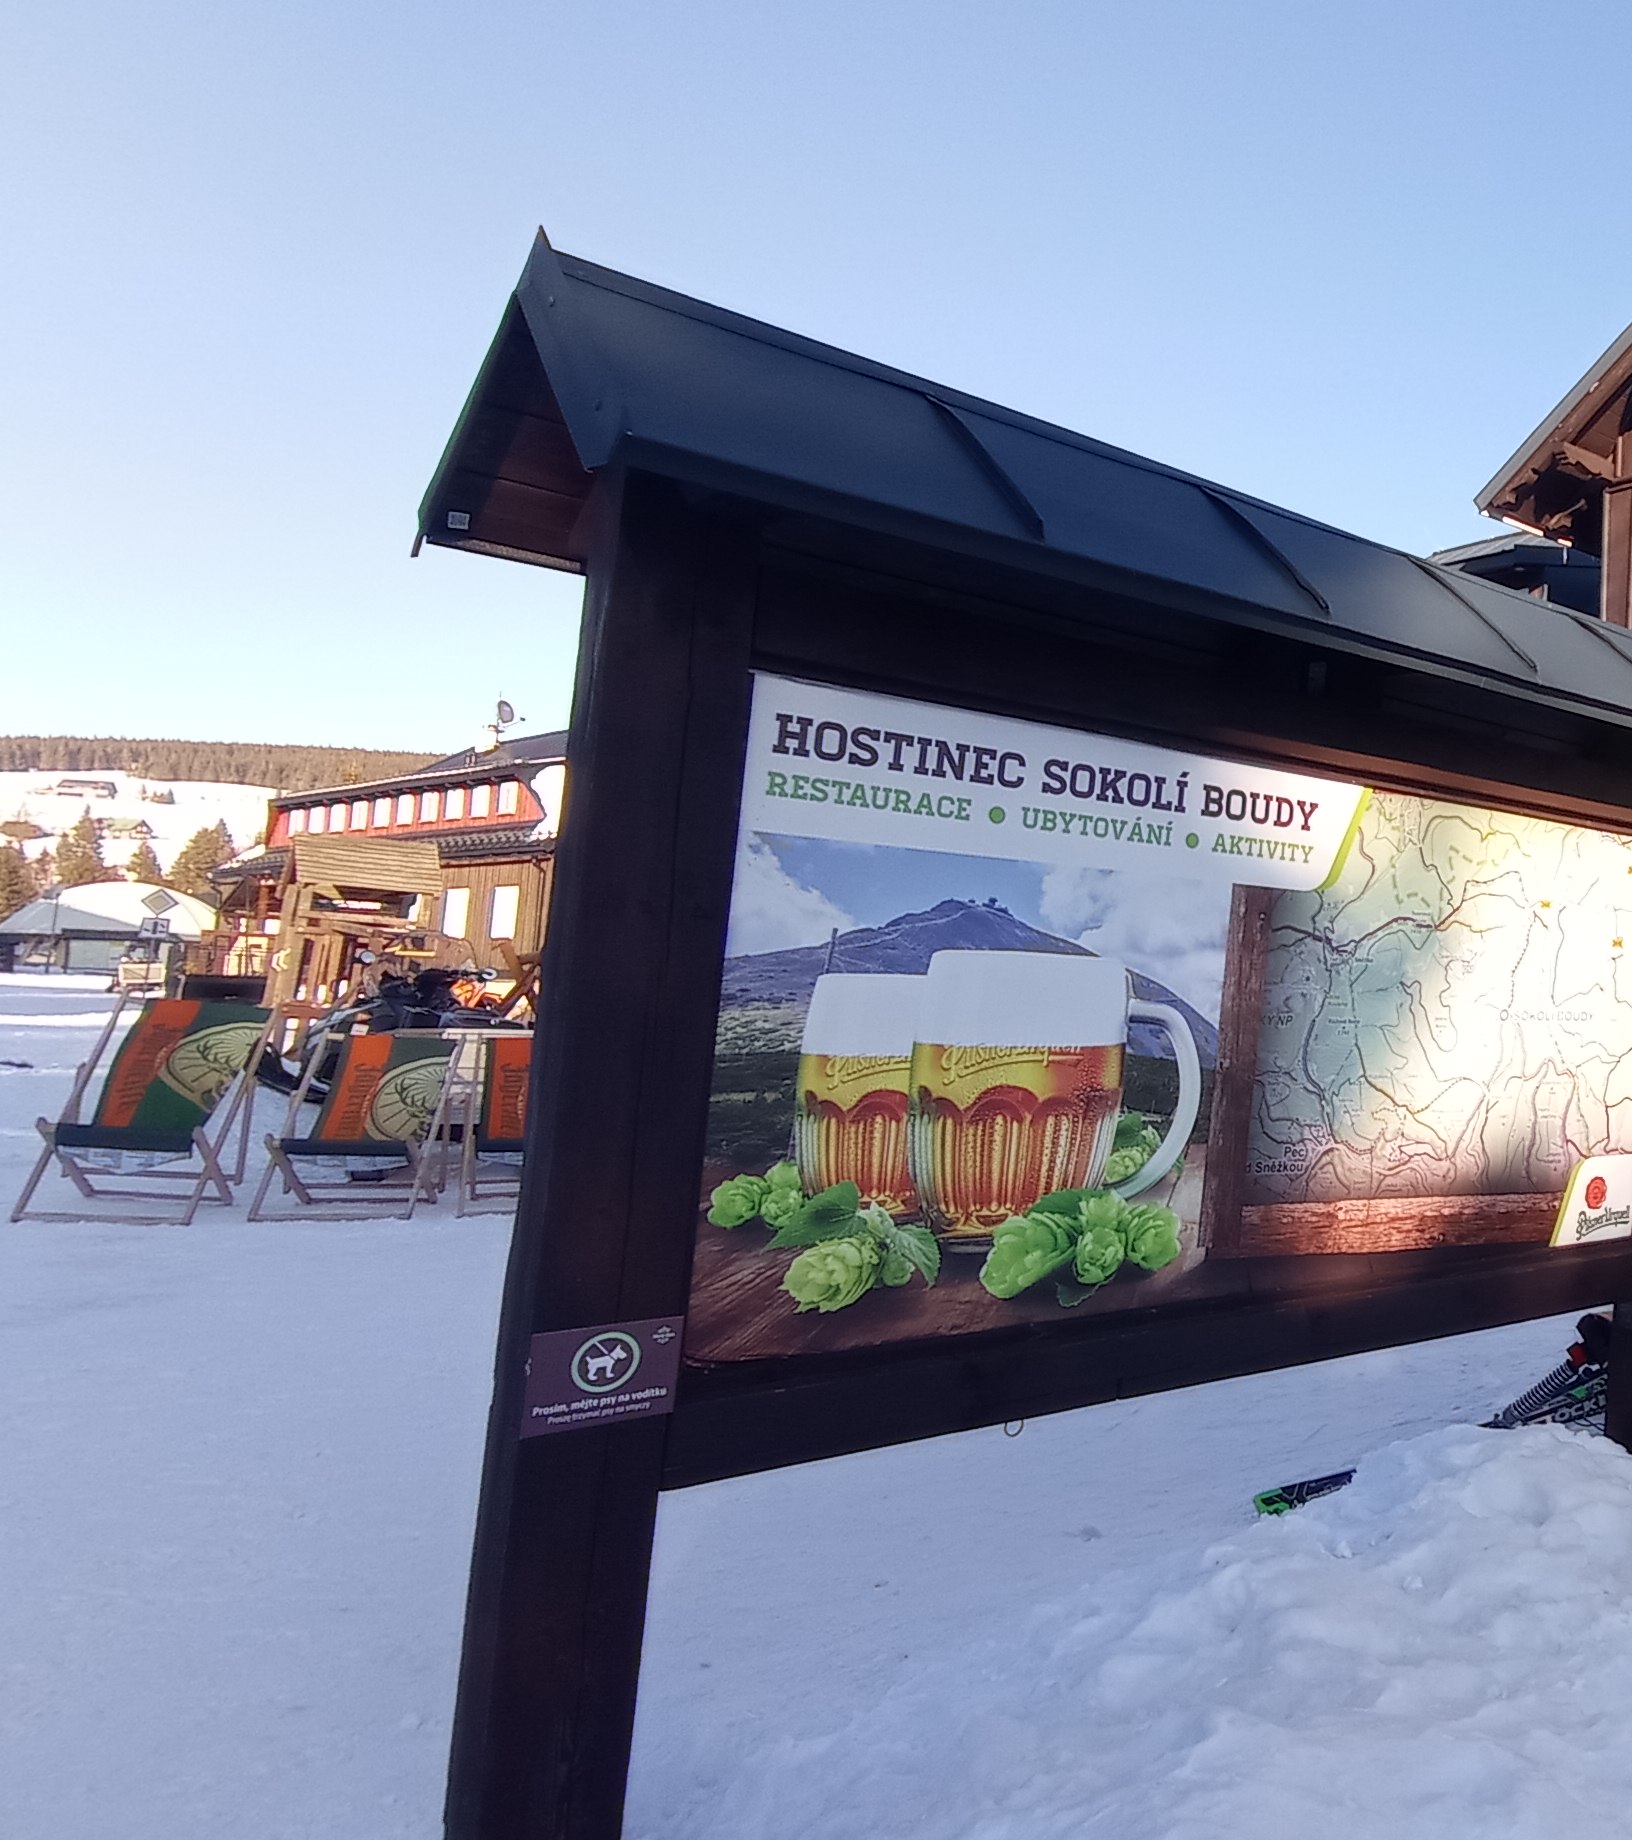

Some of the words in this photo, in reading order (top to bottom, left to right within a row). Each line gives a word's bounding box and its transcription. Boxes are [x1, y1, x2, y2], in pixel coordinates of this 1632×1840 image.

[771, 713, 1027, 789] HOSTINEC
[1040, 758, 1191, 814] SOKOLÍ
[1200, 783, 1320, 832] BOUDY
[765, 770, 973, 822] RESTAURACE
[1021, 806, 1174, 847] UBYTOVÁNÍ
[1210, 833, 1315, 864] AKTIVITY
[1283, 1146, 1306, 1158] Pec
[1254, 1160, 1304, 1174] Sněžkou
[532, 1403, 569, 1417] Prosím,
[600, 1395, 617, 1407] psy
[618, 1393, 630, 1402] na
